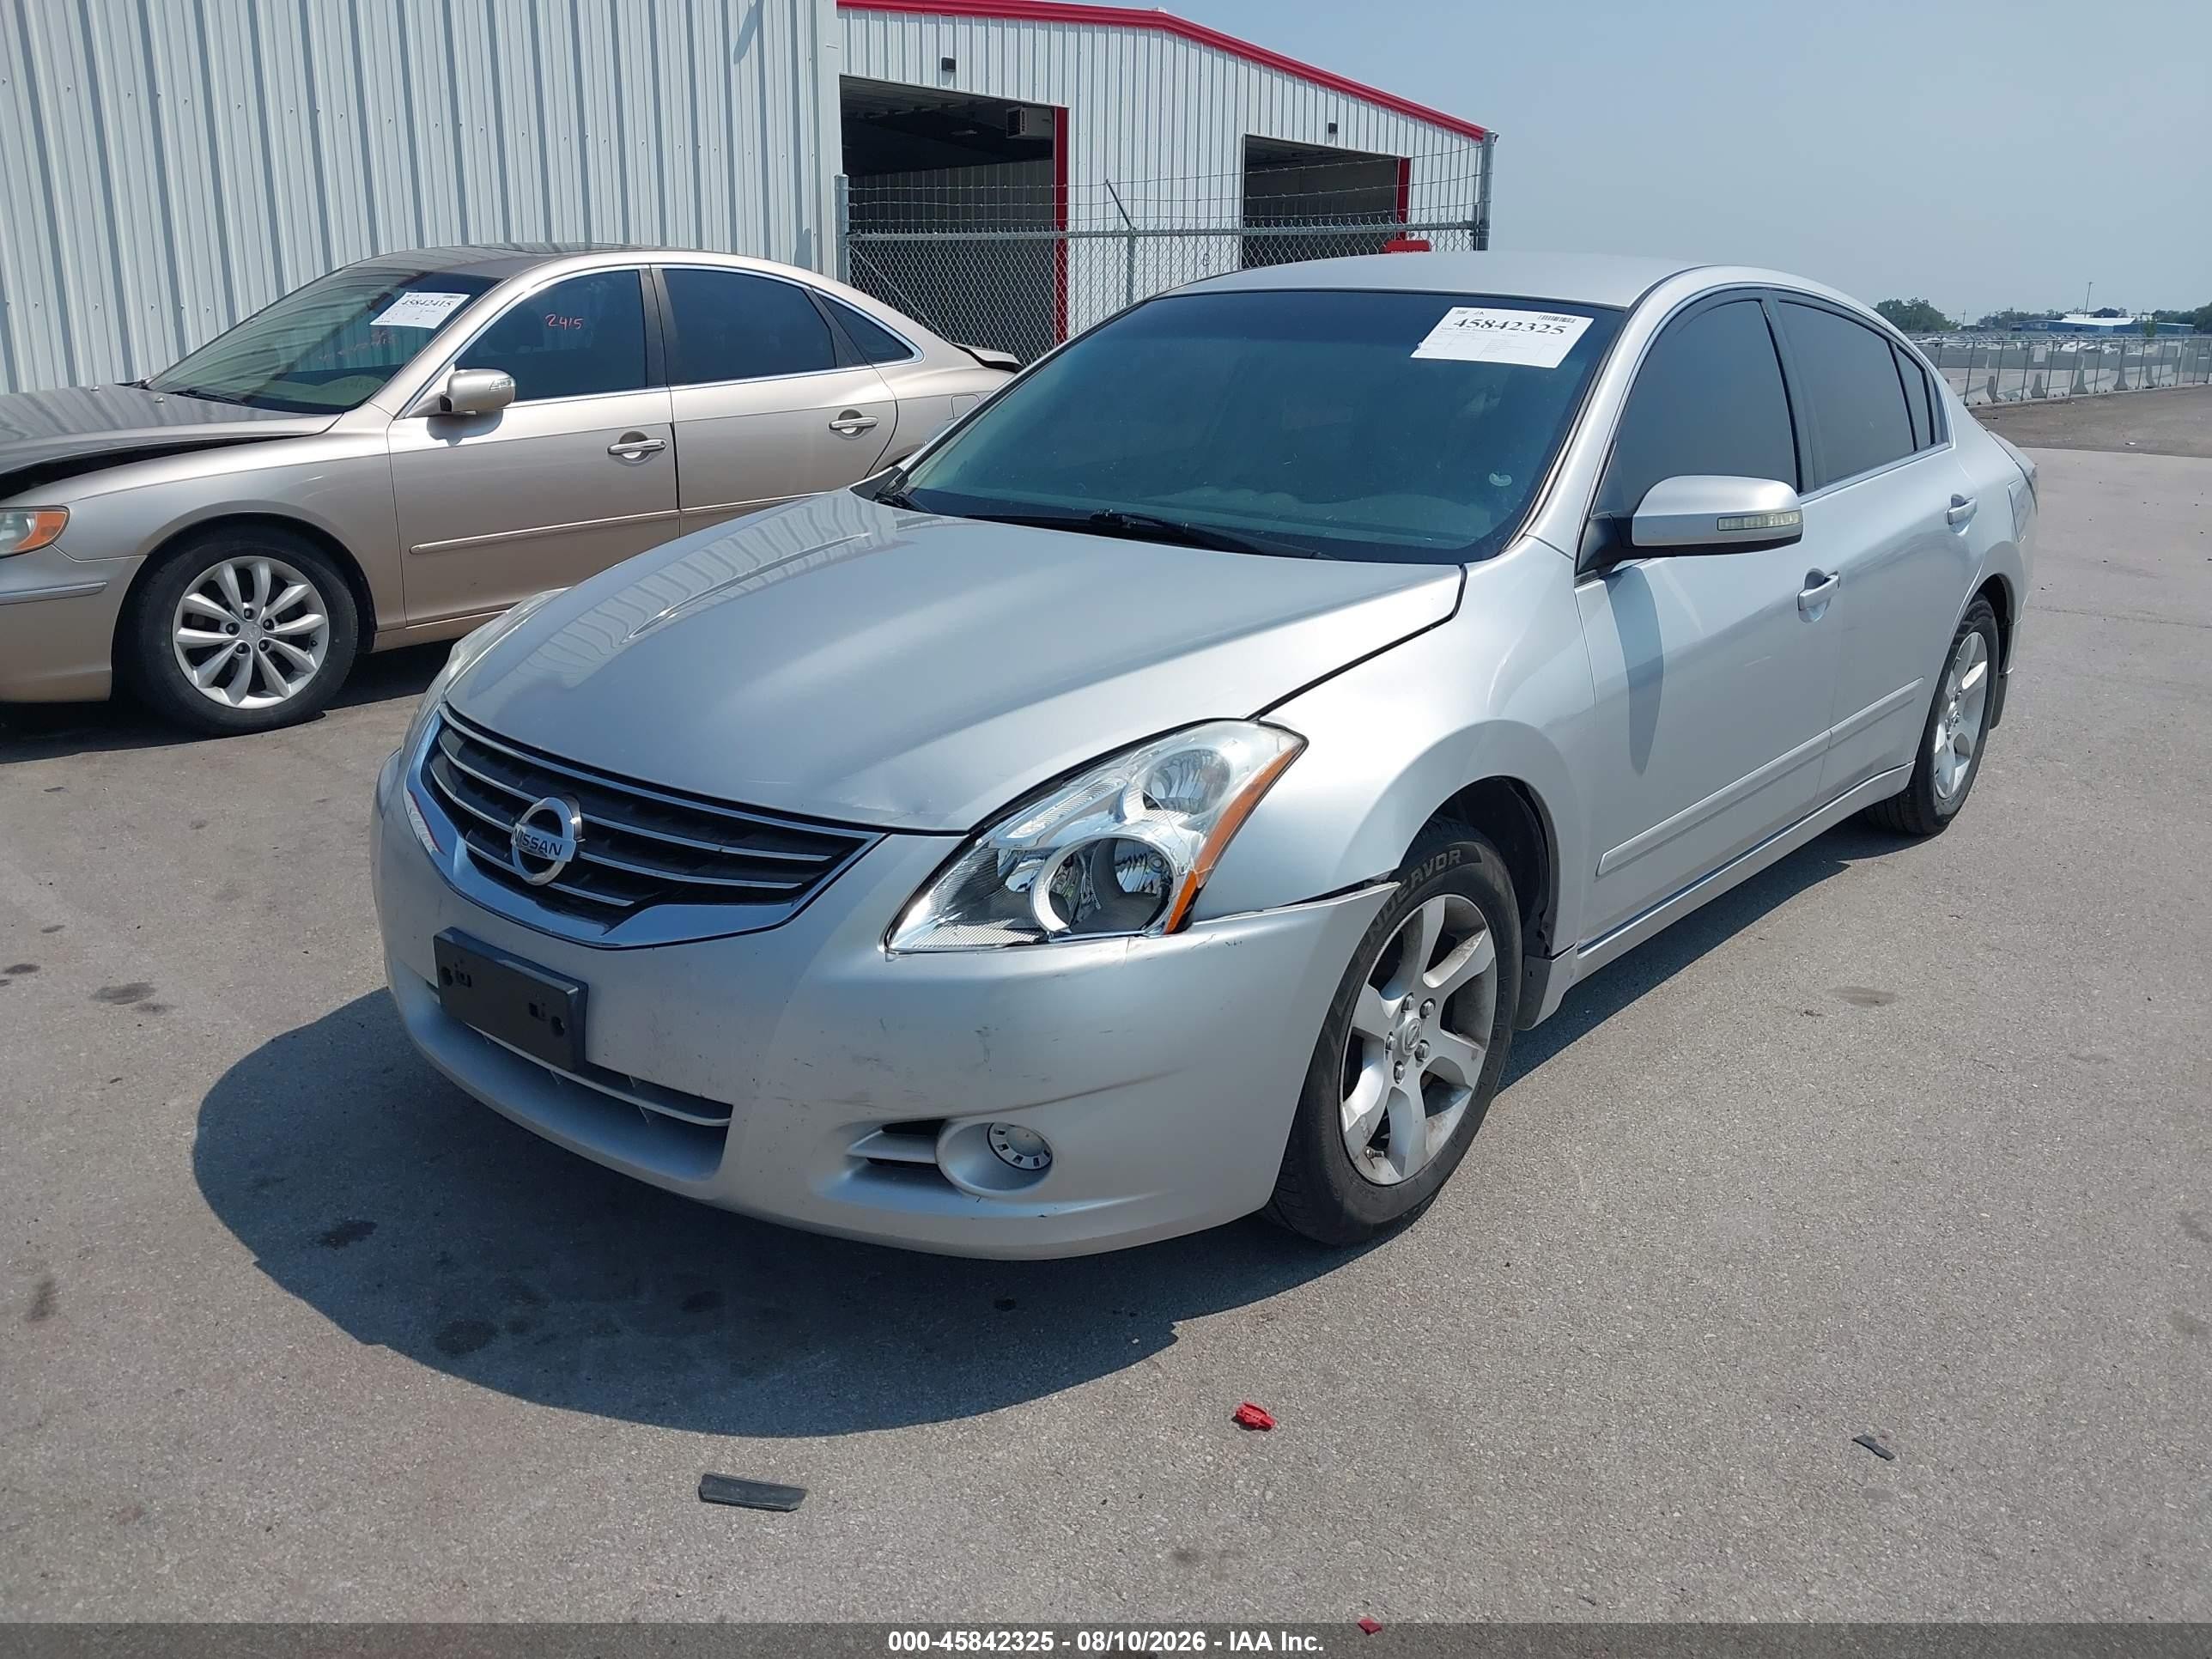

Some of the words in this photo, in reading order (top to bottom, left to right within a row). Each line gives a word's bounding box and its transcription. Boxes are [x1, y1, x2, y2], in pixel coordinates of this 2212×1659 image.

[544, 313, 584, 331] 2415
[1453, 317, 1567, 336] 45842325
[515, 827, 563, 857] NISSAN
